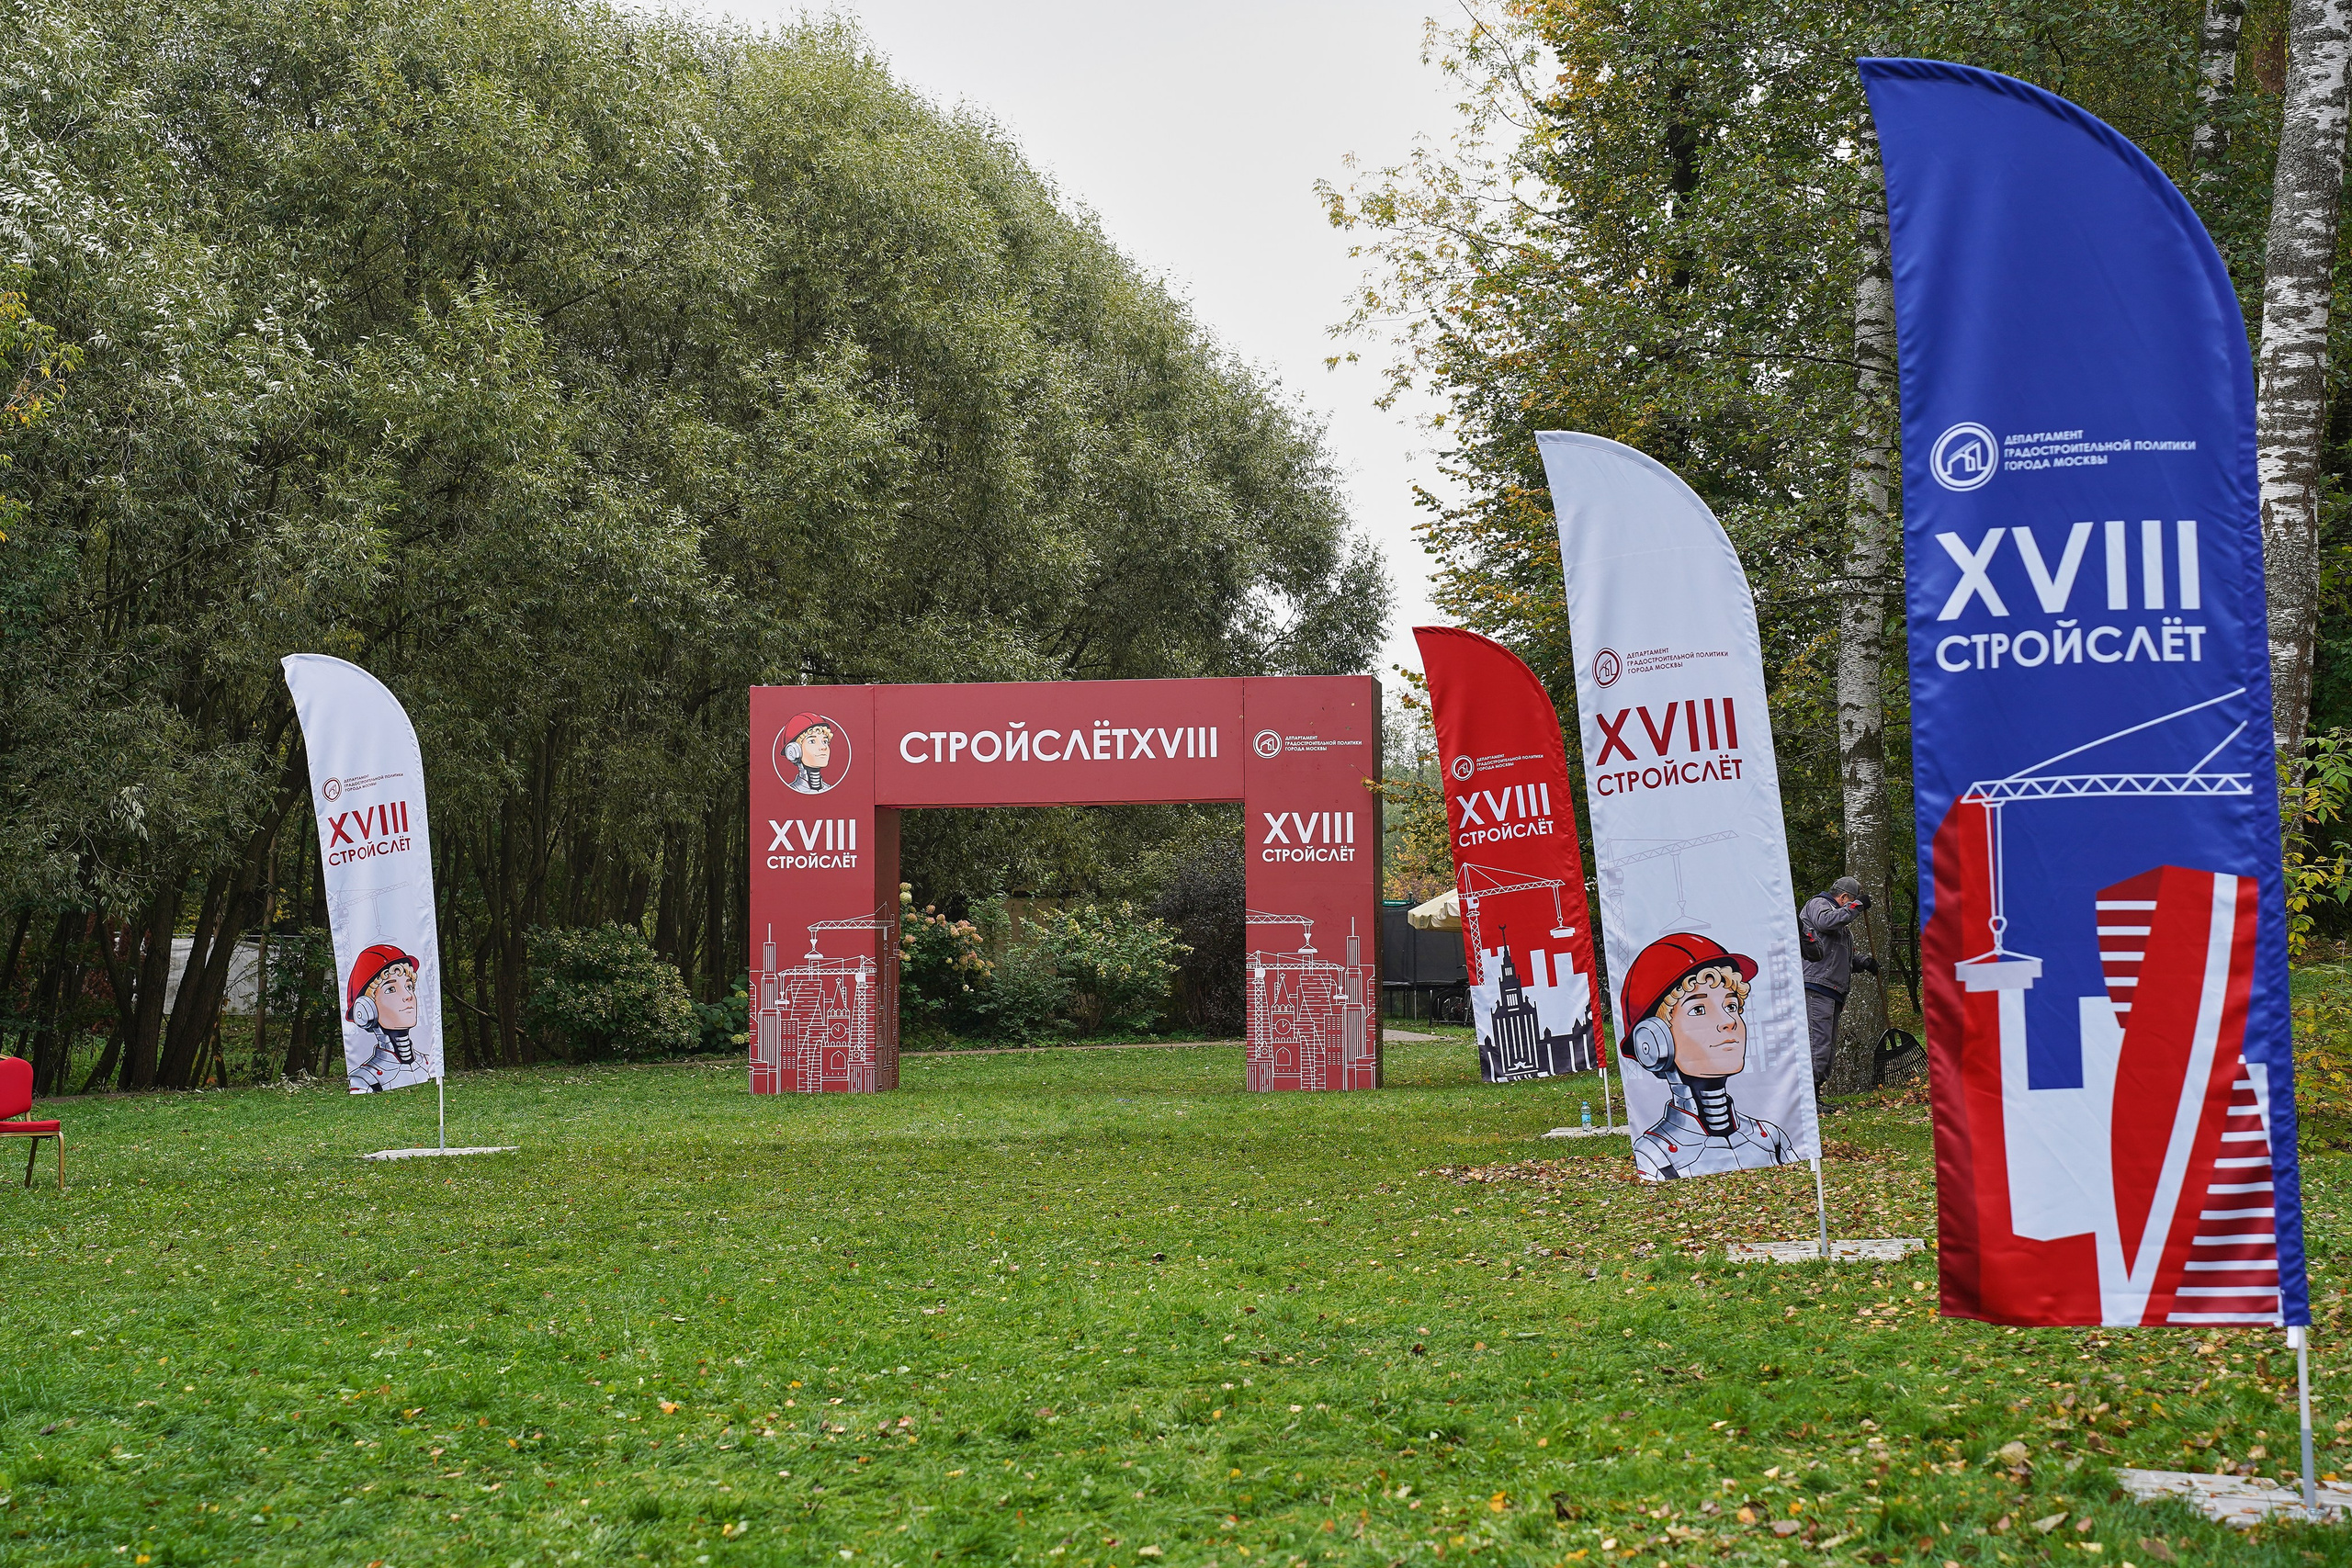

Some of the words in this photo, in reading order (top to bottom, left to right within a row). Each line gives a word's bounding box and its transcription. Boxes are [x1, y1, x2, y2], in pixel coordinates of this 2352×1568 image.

[2004, 429, 2084, 446] ДЕПАРТАМЕНТ
[2004, 439, 2132, 458] ГРАДОСТРОИТЕЛЬНОЙ
[2133, 441, 2197, 451] ПОЛИТИКИ
[2004, 459, 2051, 471] ГОРОДА
[2052, 455, 2109, 468] МОСКВЫ
[1934, 520, 2200, 622] XVIII
[1626, 648, 1669, 660] ДЕПАРТАМЕНТ
[1626, 651, 1694, 667] ГРАДОСТРОИТЕЛЬНОЙ
[1936, 616, 2206, 672] СТРОЙСЛЁТ
[1627, 665, 1654, 674] ГОРОДА
[1655, 661, 1683, 671] МОСКВЫ
[1596, 697, 1738, 766] XVIII
[1597, 754, 1742, 796] СТРОЙСЛЁТ
[1455, 783, 1551, 829] XVIII
[328, 800, 409, 849] XVIII
[767, 818, 856, 852] XVIII
[1262, 811, 1354, 844] XVIII
[1458, 818, 1554, 847] СТРОЙСЛЁТ
[329, 835, 411, 866] СТРОЙСЛЁТ
[766, 852, 857, 869] СТРОЙСЛЁТ
[1261, 845, 1355, 863] СТРОЙСЛЁТ
